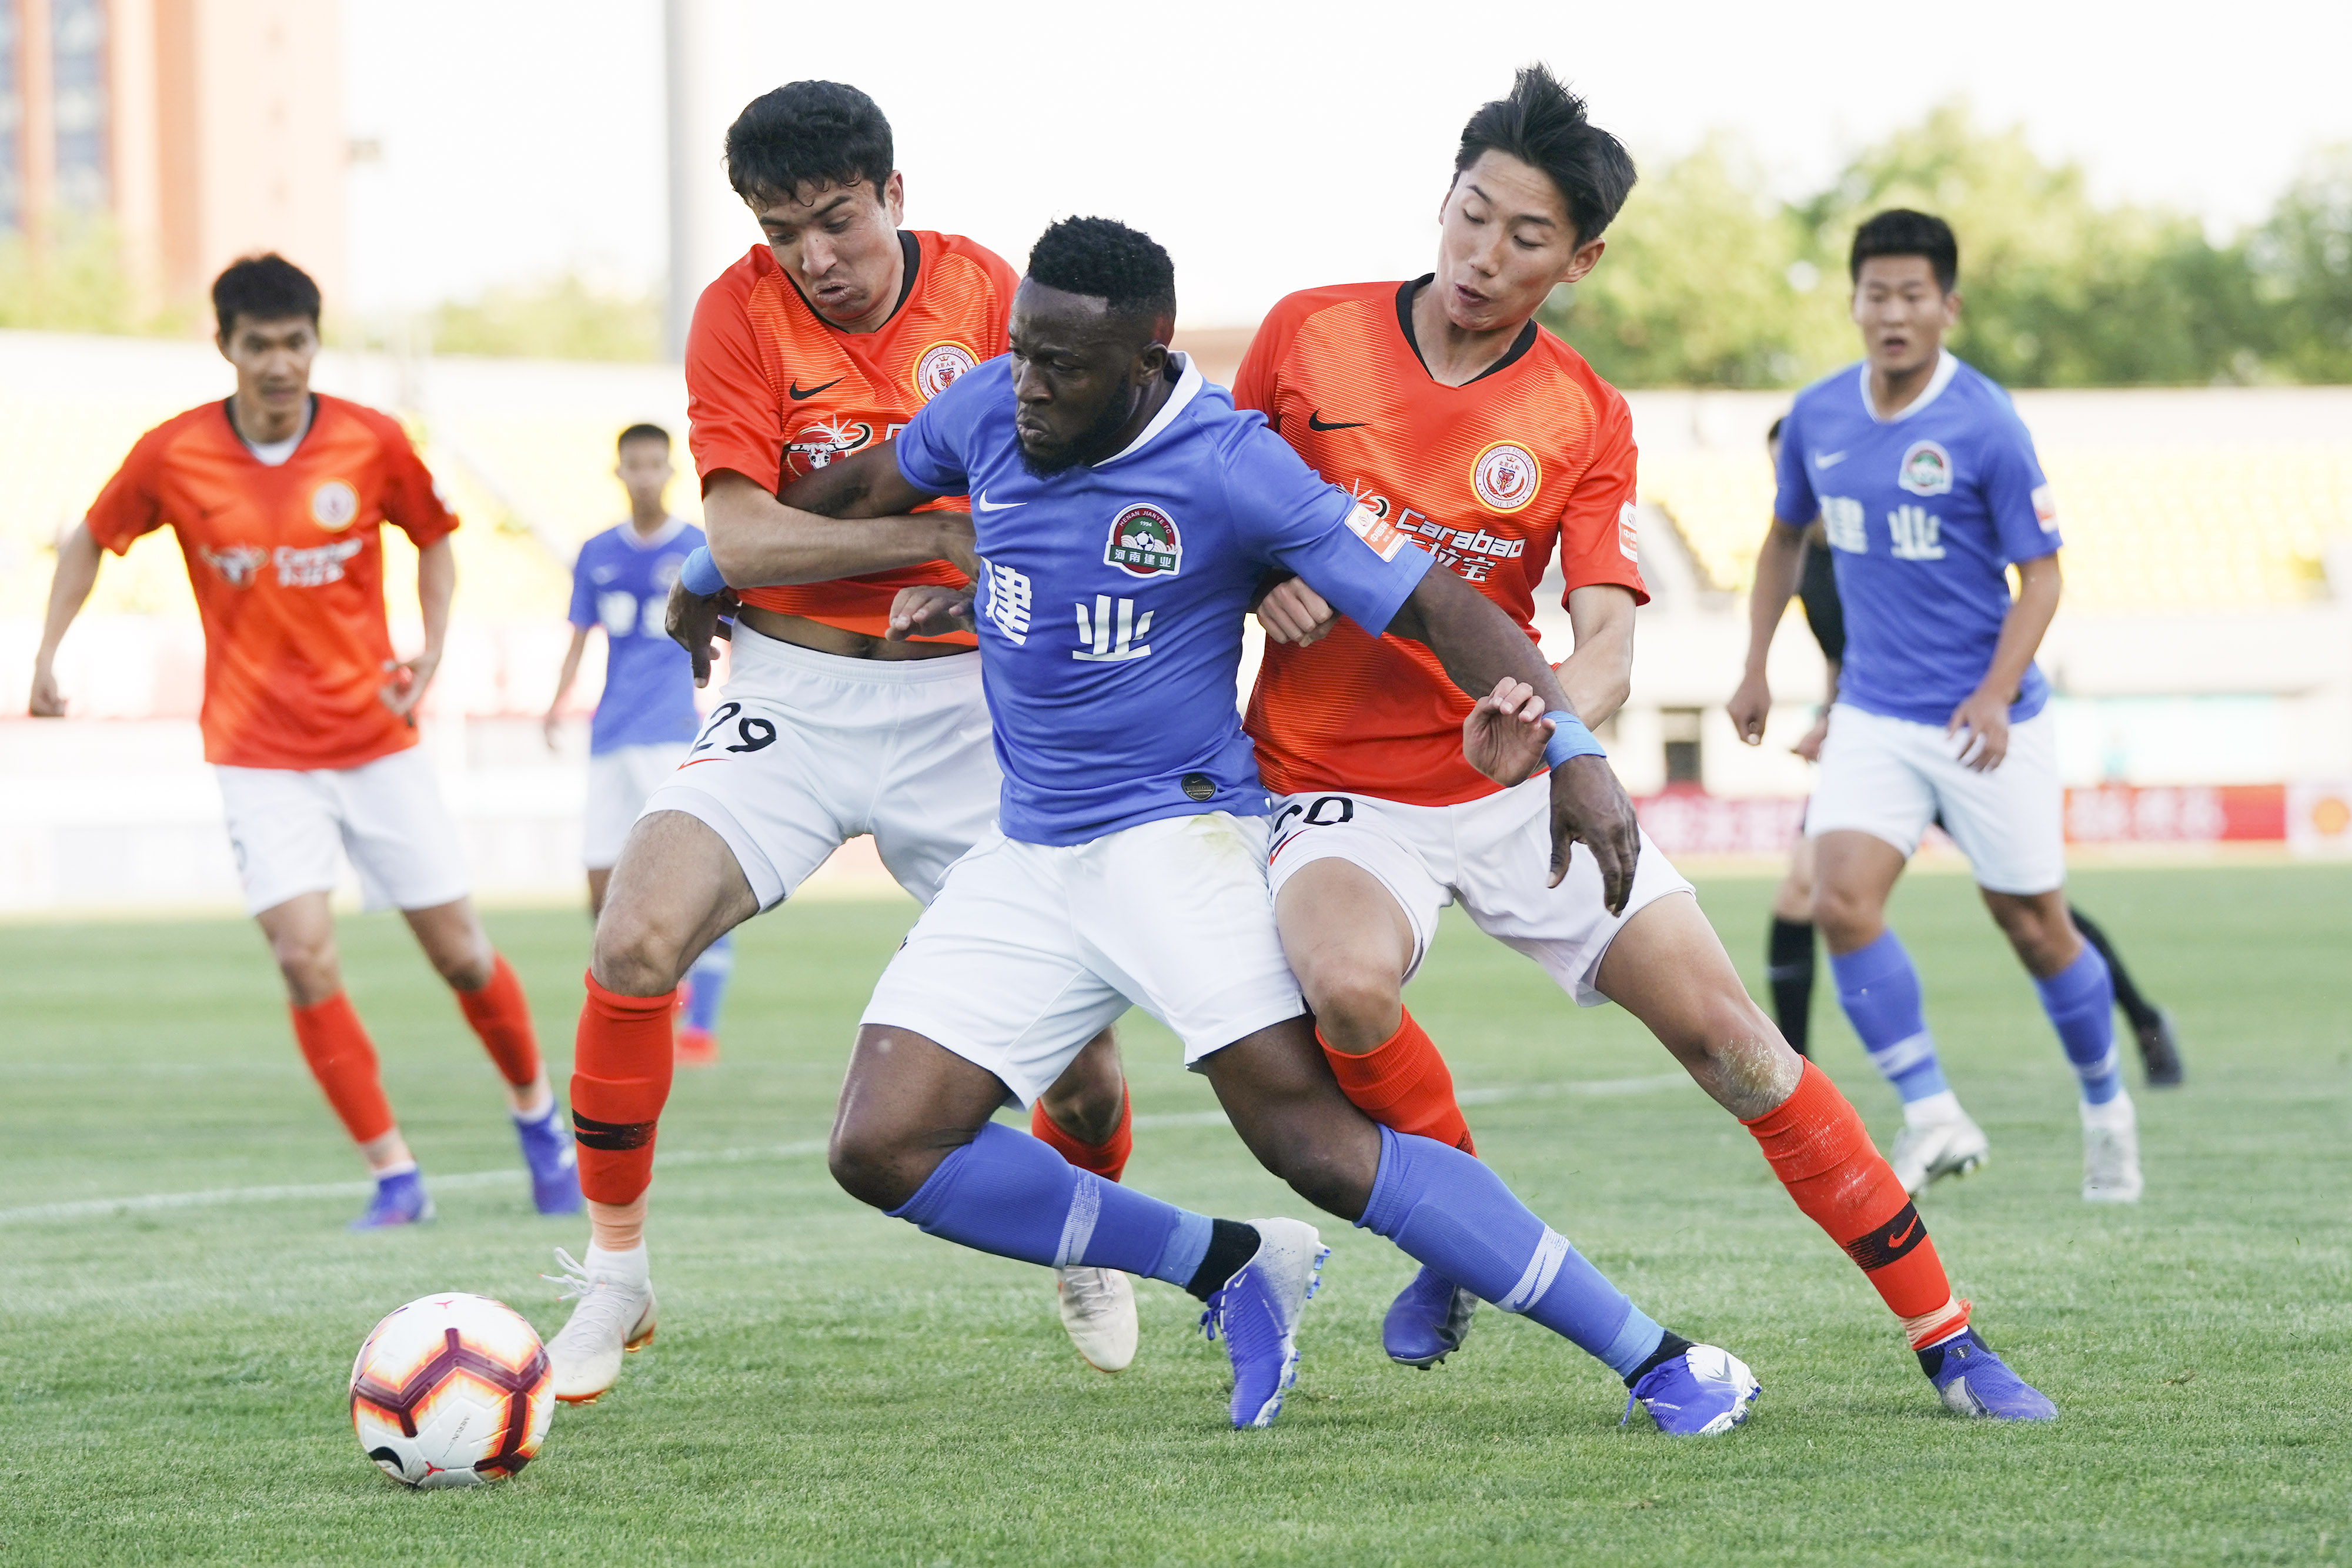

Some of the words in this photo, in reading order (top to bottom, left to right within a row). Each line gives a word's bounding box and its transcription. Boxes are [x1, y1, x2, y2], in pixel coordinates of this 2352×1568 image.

[923, 349, 940, 364] RENHE
[941, 347, 970, 363] FOOTBALL
[1477, 455, 1491, 477] BEIJING
[1490, 447, 1511, 456] RENHE
[1512, 448, 1535, 475] FOOTBALL
[1527, 476, 1535, 492] CLUB
[1482, 492, 1504, 507] RENHE
[1119, 511, 1140, 526] HENAN
[1142, 511, 1164, 524] JIANYE
[1163, 525, 1172, 534] FC
[1395, 507, 1526, 558] Carabao
[1114, 549, 1171, 567] 河南建业
[689, 702, 777, 757] 29
